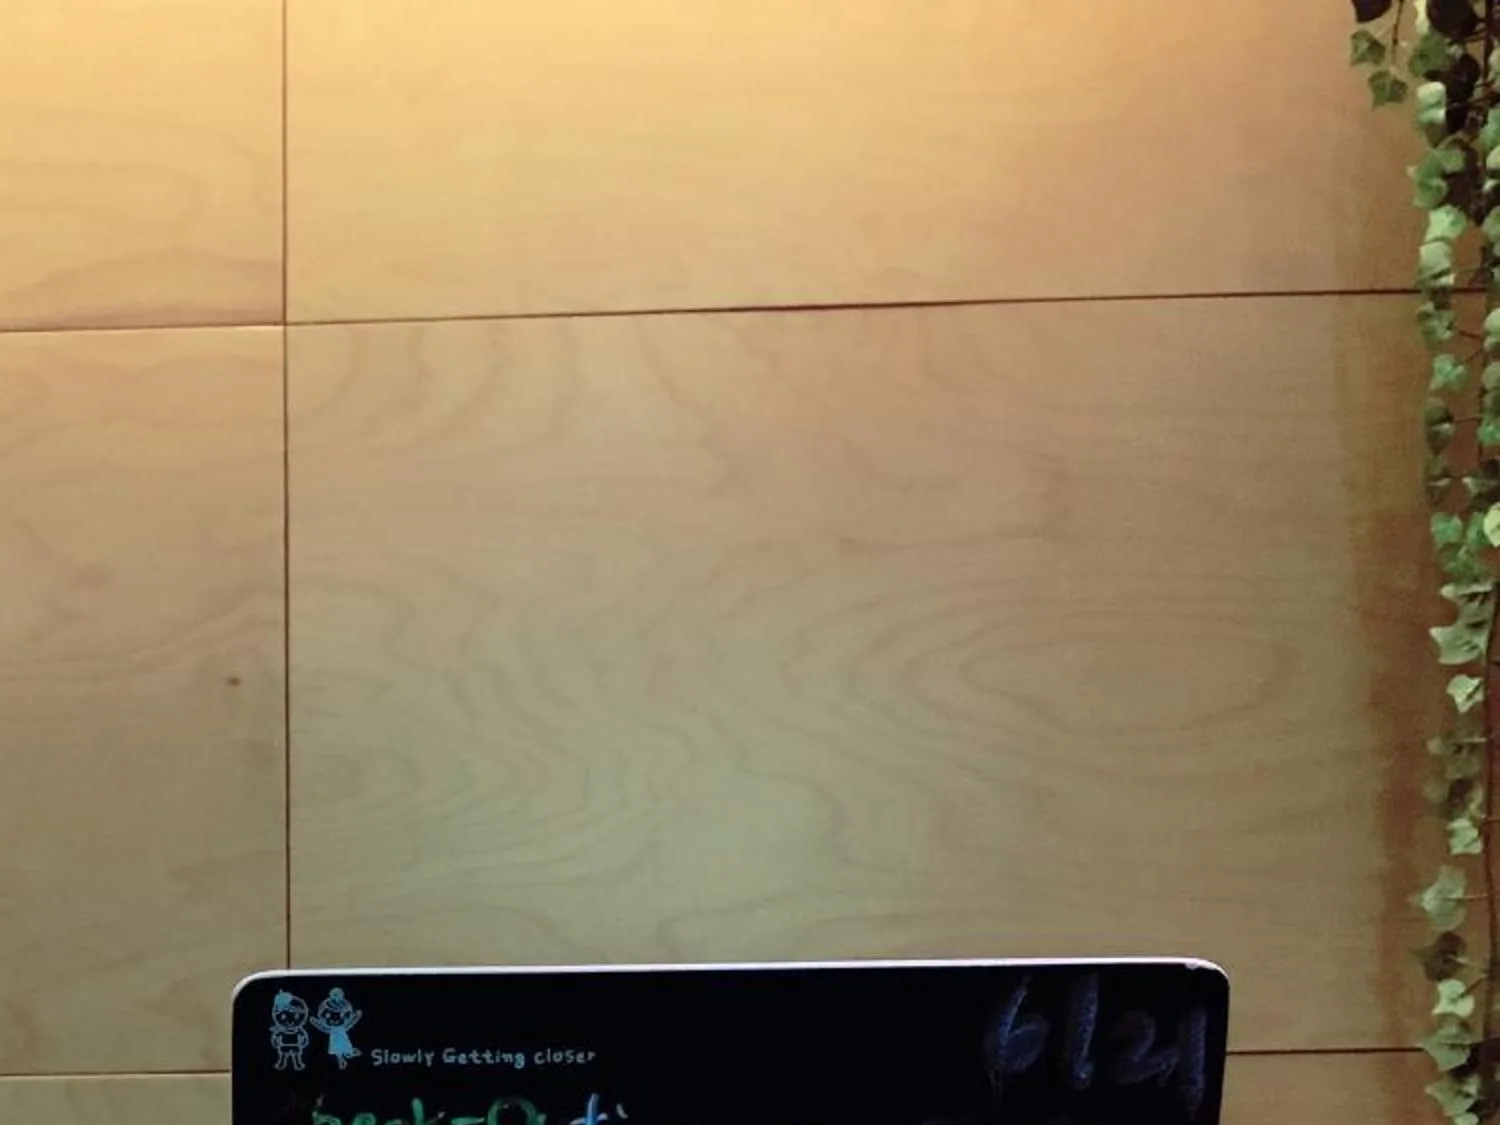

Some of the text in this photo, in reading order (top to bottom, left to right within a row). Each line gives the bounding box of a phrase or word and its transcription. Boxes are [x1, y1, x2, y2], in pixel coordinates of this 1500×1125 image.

[371, 1047, 597, 1069] Slowly Getting closer
